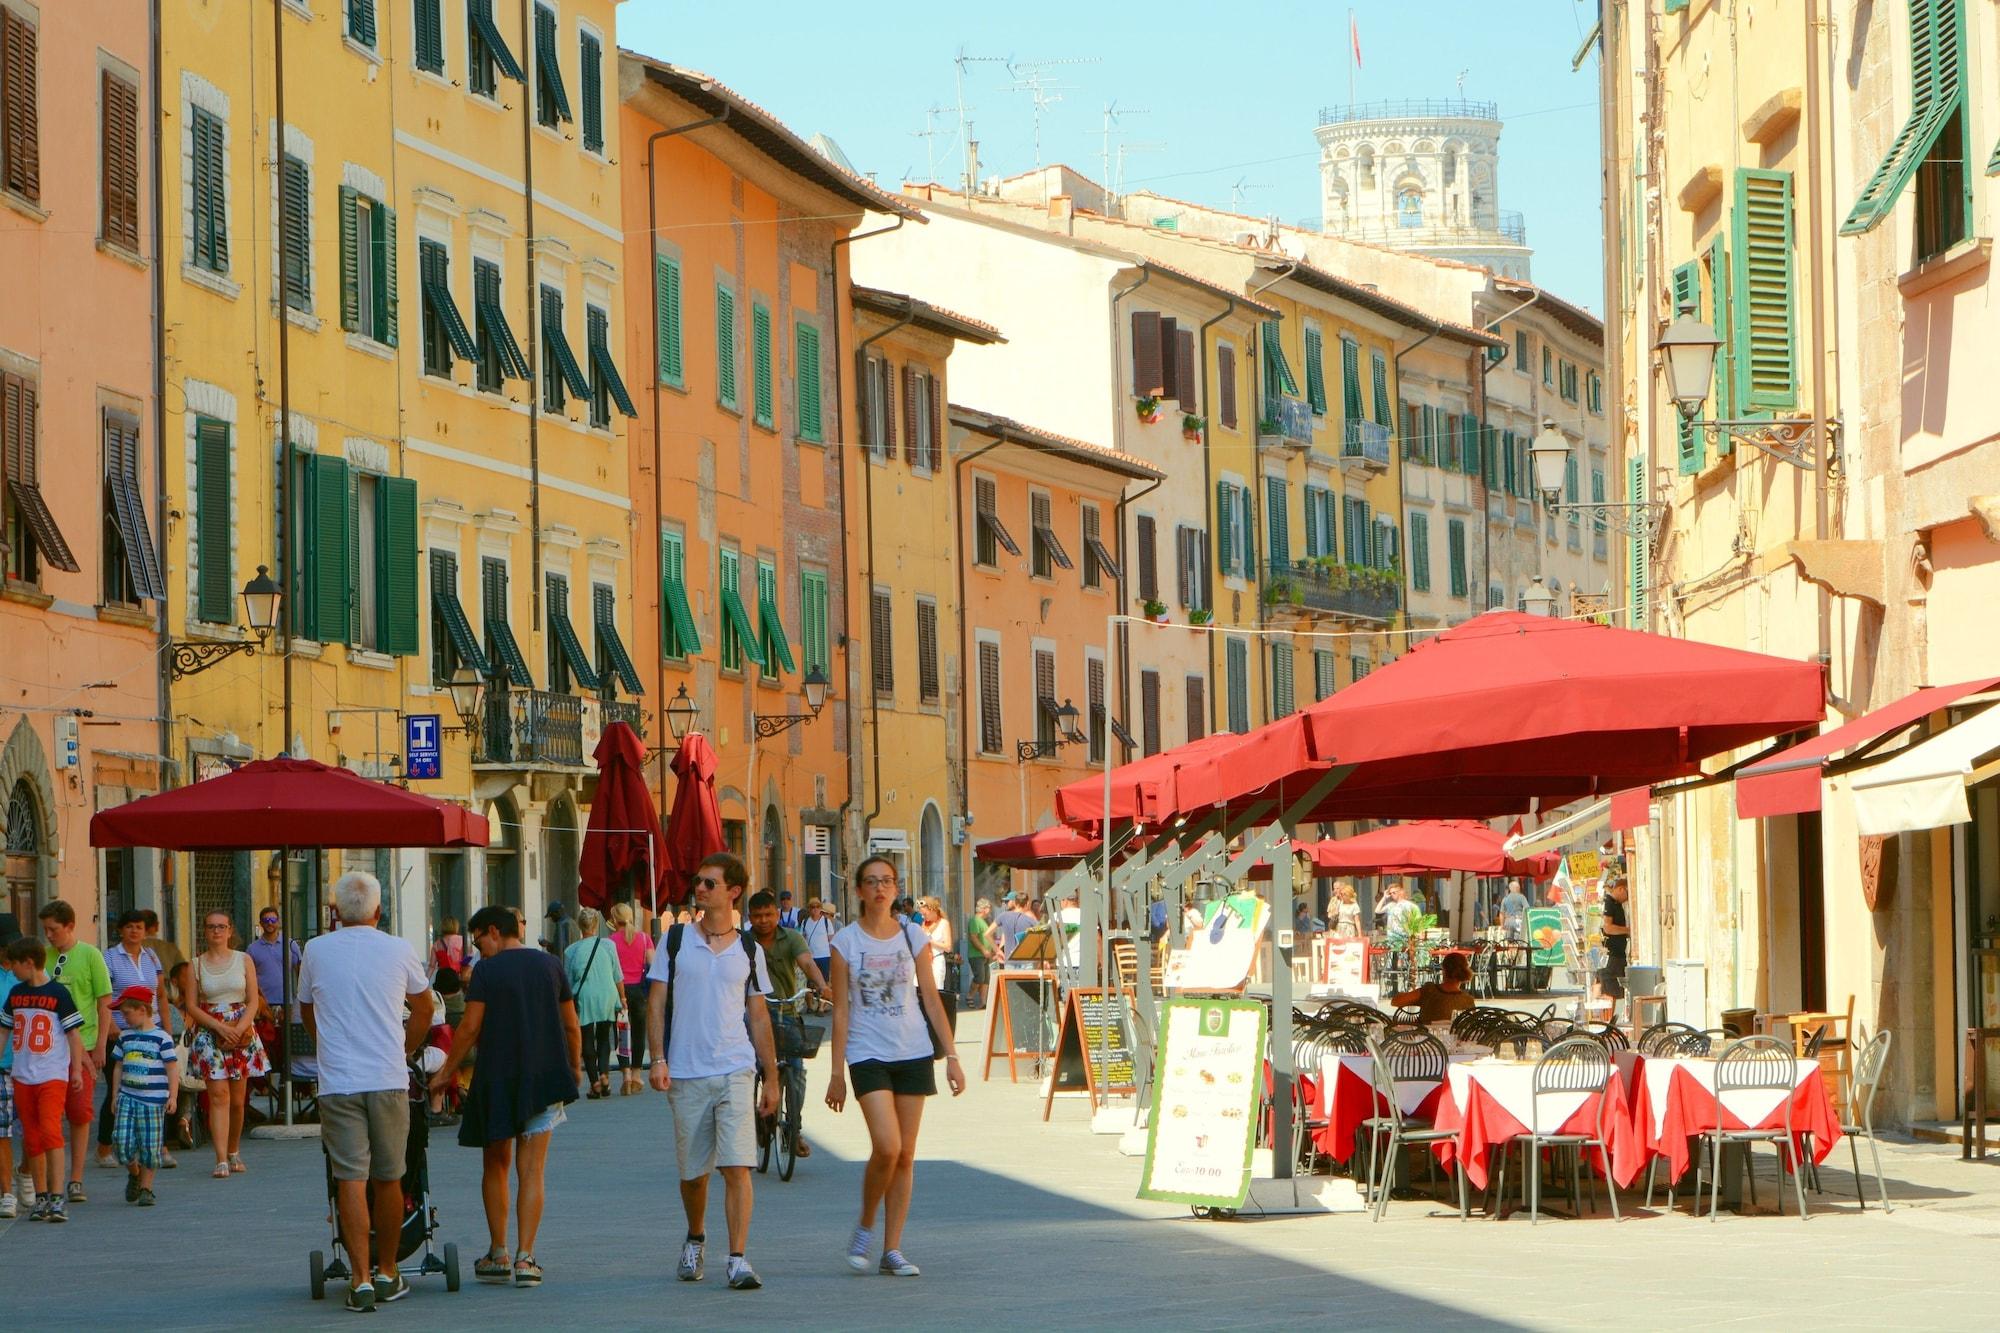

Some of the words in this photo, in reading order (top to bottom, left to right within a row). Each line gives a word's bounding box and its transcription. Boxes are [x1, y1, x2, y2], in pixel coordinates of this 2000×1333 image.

[1572, 852, 1594, 863] STAMPS
[1588, 865, 1600, 874] BOX
[12, 1012, 53, 1055] 98
